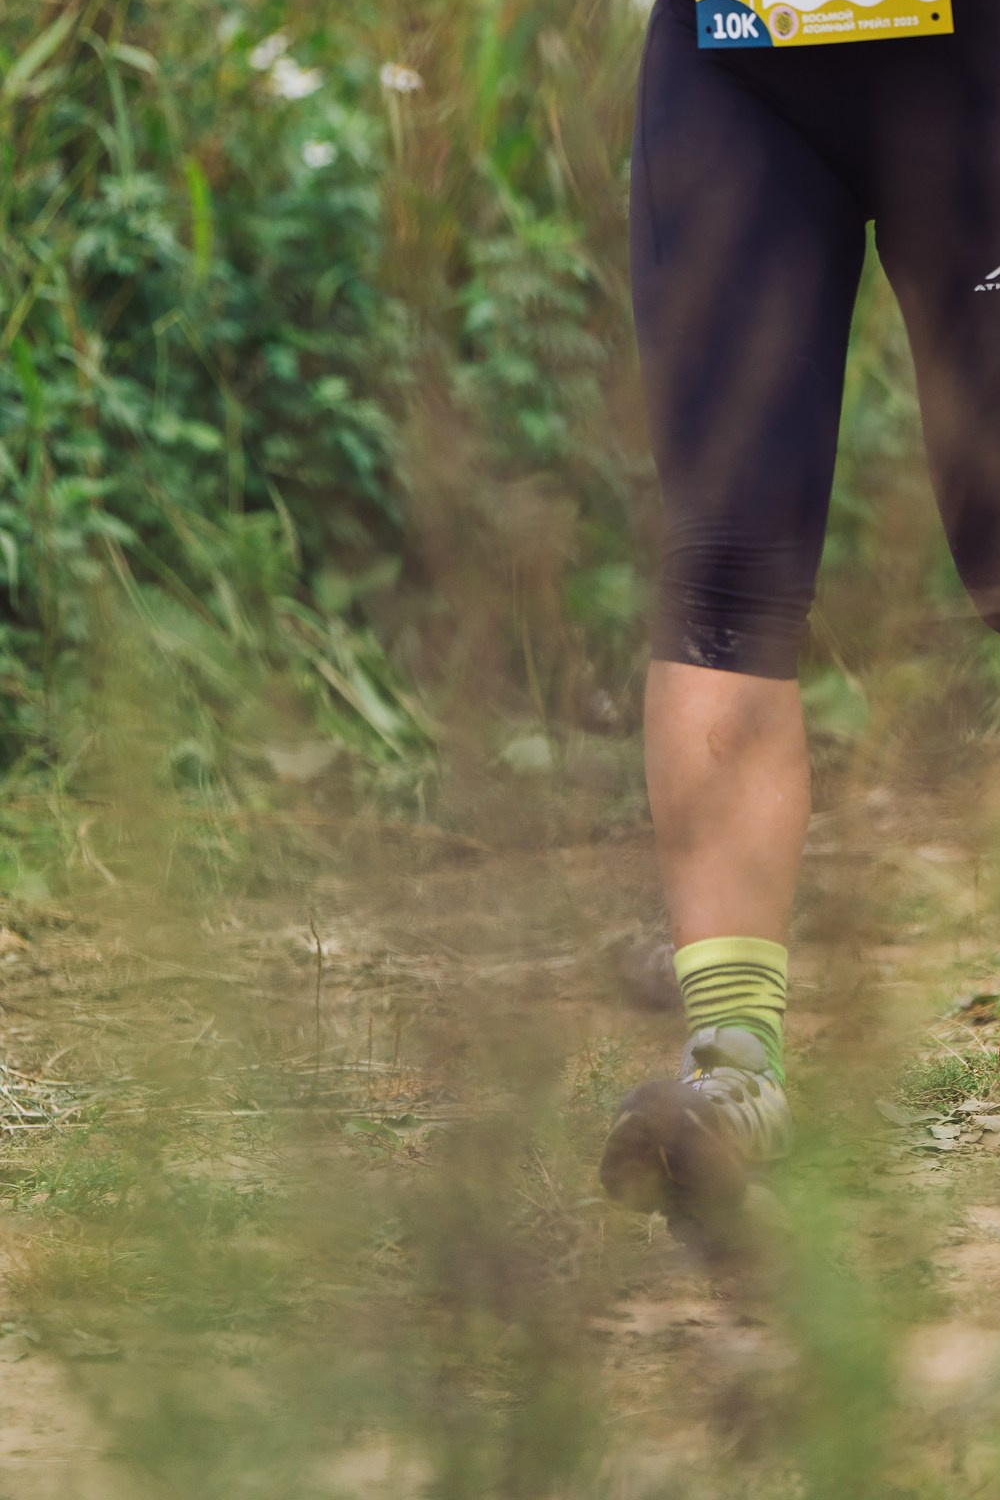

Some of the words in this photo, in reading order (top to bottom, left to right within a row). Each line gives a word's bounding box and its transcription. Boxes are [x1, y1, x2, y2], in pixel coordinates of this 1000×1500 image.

[802, 9, 854, 23] ВОСЬМОЙ
[713, 13, 759, 40] 10K
[803, 21, 856, 34] АТОМНЫЙ
[858, 17, 891, 30] ТРЕЙЛ
